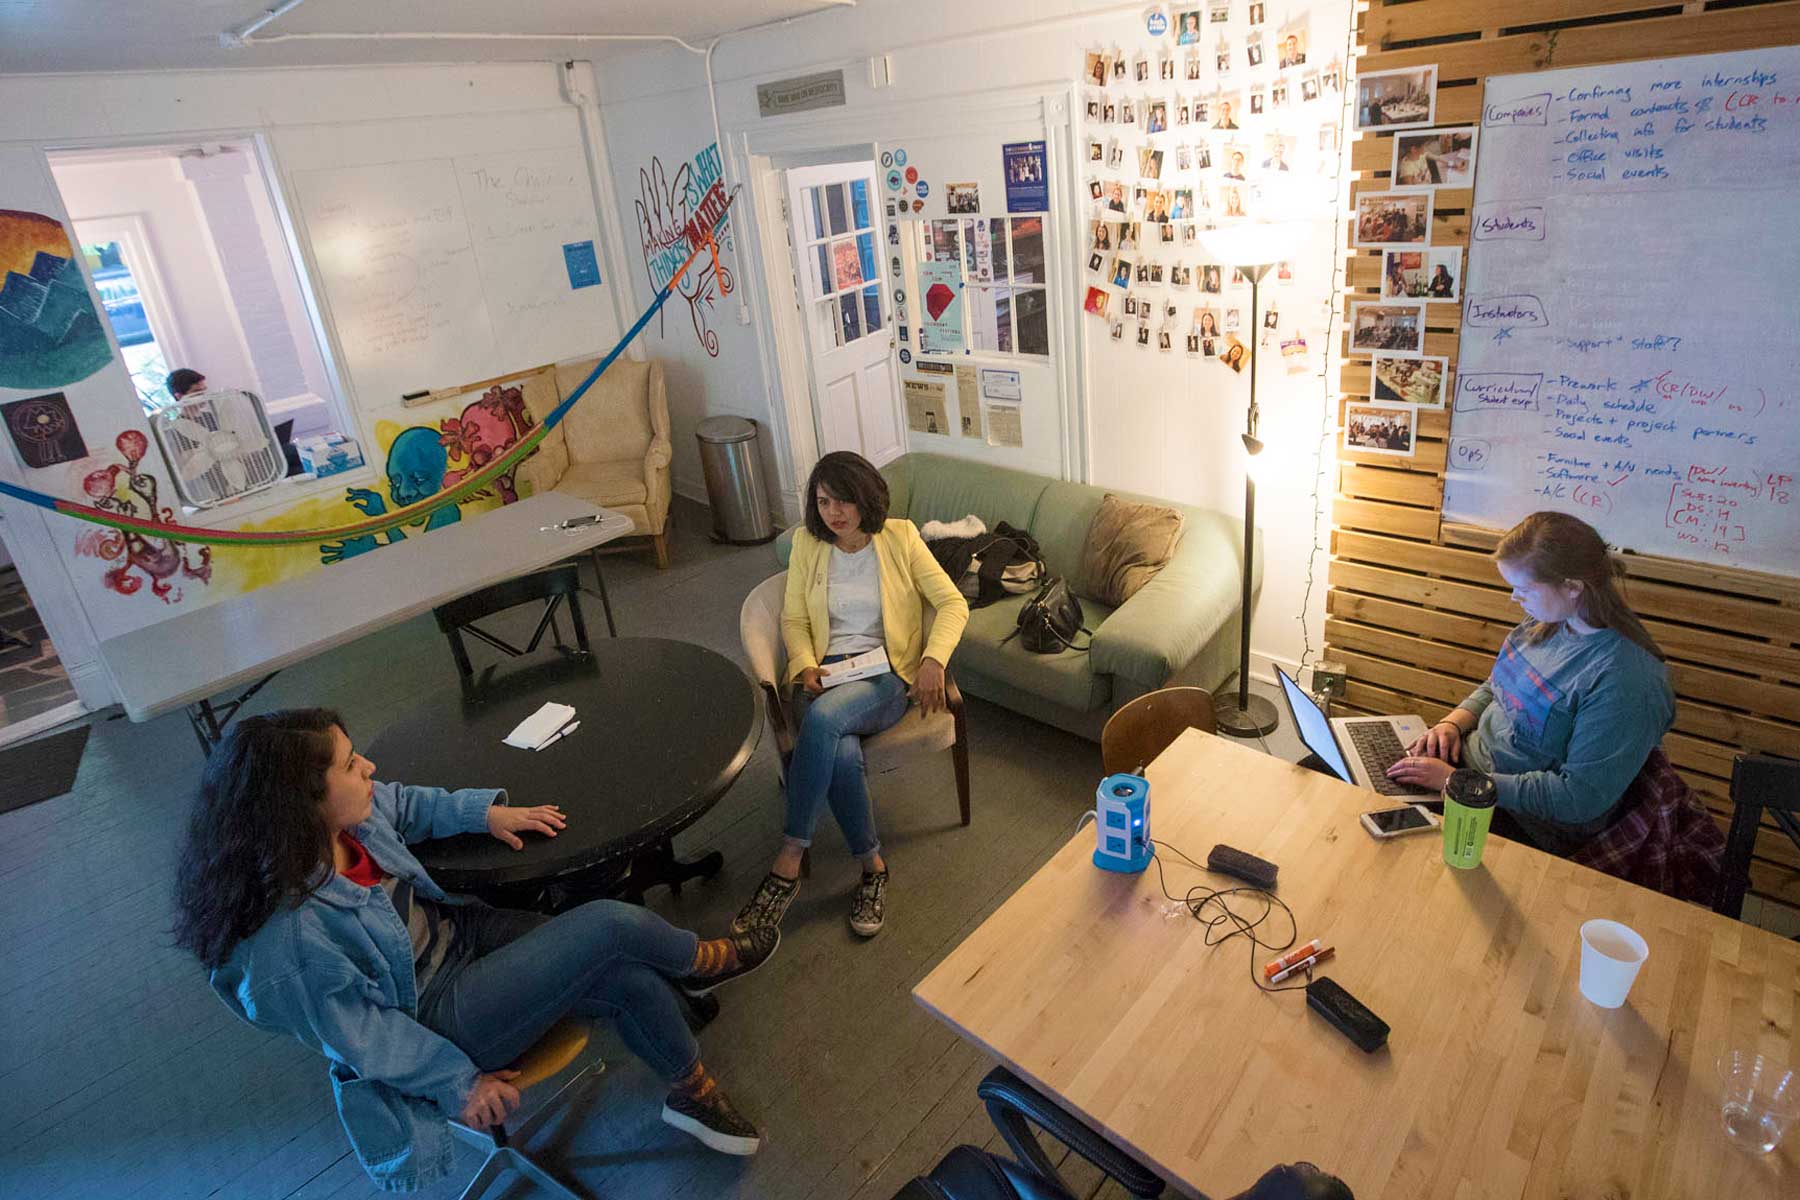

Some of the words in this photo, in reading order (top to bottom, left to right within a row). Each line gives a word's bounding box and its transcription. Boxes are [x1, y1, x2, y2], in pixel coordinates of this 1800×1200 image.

[1568, 84, 1631, 102] Confirming
[1650, 80, 1681, 92] more
[1701, 69, 1777, 88] internships
[1488, 104, 1542, 123] Companies
[1569, 105, 1609, 122] Formal
[1565, 128, 1619, 144] Collecting
[1633, 122, 1655, 137] info
[1674, 117, 1697, 134] for
[1704, 114, 1767, 134] students
[1625, 143, 1664, 160] visits
[689, 142, 723, 197] WHAT
[1566, 168, 1606, 181] Social
[1622, 164, 1670, 180] events
[1482, 217, 1536, 233] Students
[644, 220, 682, 256] MAKING
[1472, 304, 1538, 321] Instructors
[904, 381, 929, 391] NEWS
[1559, 375, 1617, 391] Prework
[1556, 394, 1589, 414] Daily
[1603, 398, 1657, 414] schedule
[1555, 408, 1603, 425] Projects
[1626, 419, 1678, 433] project
[1692, 426, 1759, 446] partners
[1554, 427, 1586, 441] Social
[1594, 434, 1633, 449] events
[1546, 467, 1599, 483] Software
[1644, 463, 1682, 481] needs
